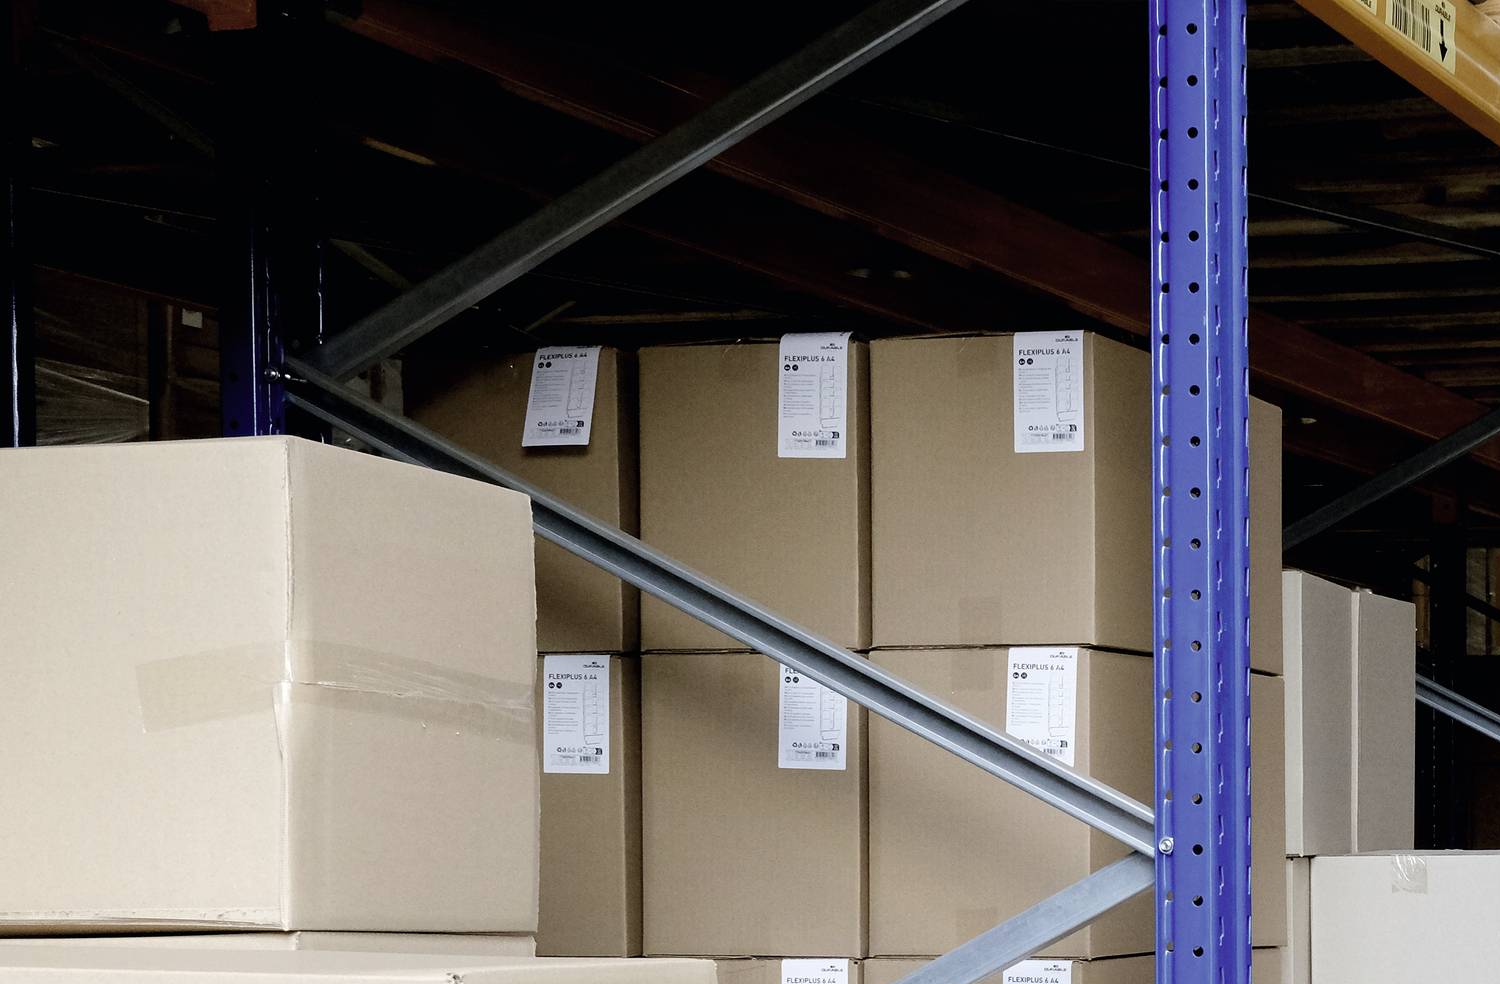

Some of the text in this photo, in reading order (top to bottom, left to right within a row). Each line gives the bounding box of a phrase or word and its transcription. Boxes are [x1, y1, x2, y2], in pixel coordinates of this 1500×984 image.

[539, 352, 573, 360] FLEXIPLUS
[1013, 663, 1049, 671] FLEXIPLUS
[1008, 976, 1043, 984] FLEXIPLUS
